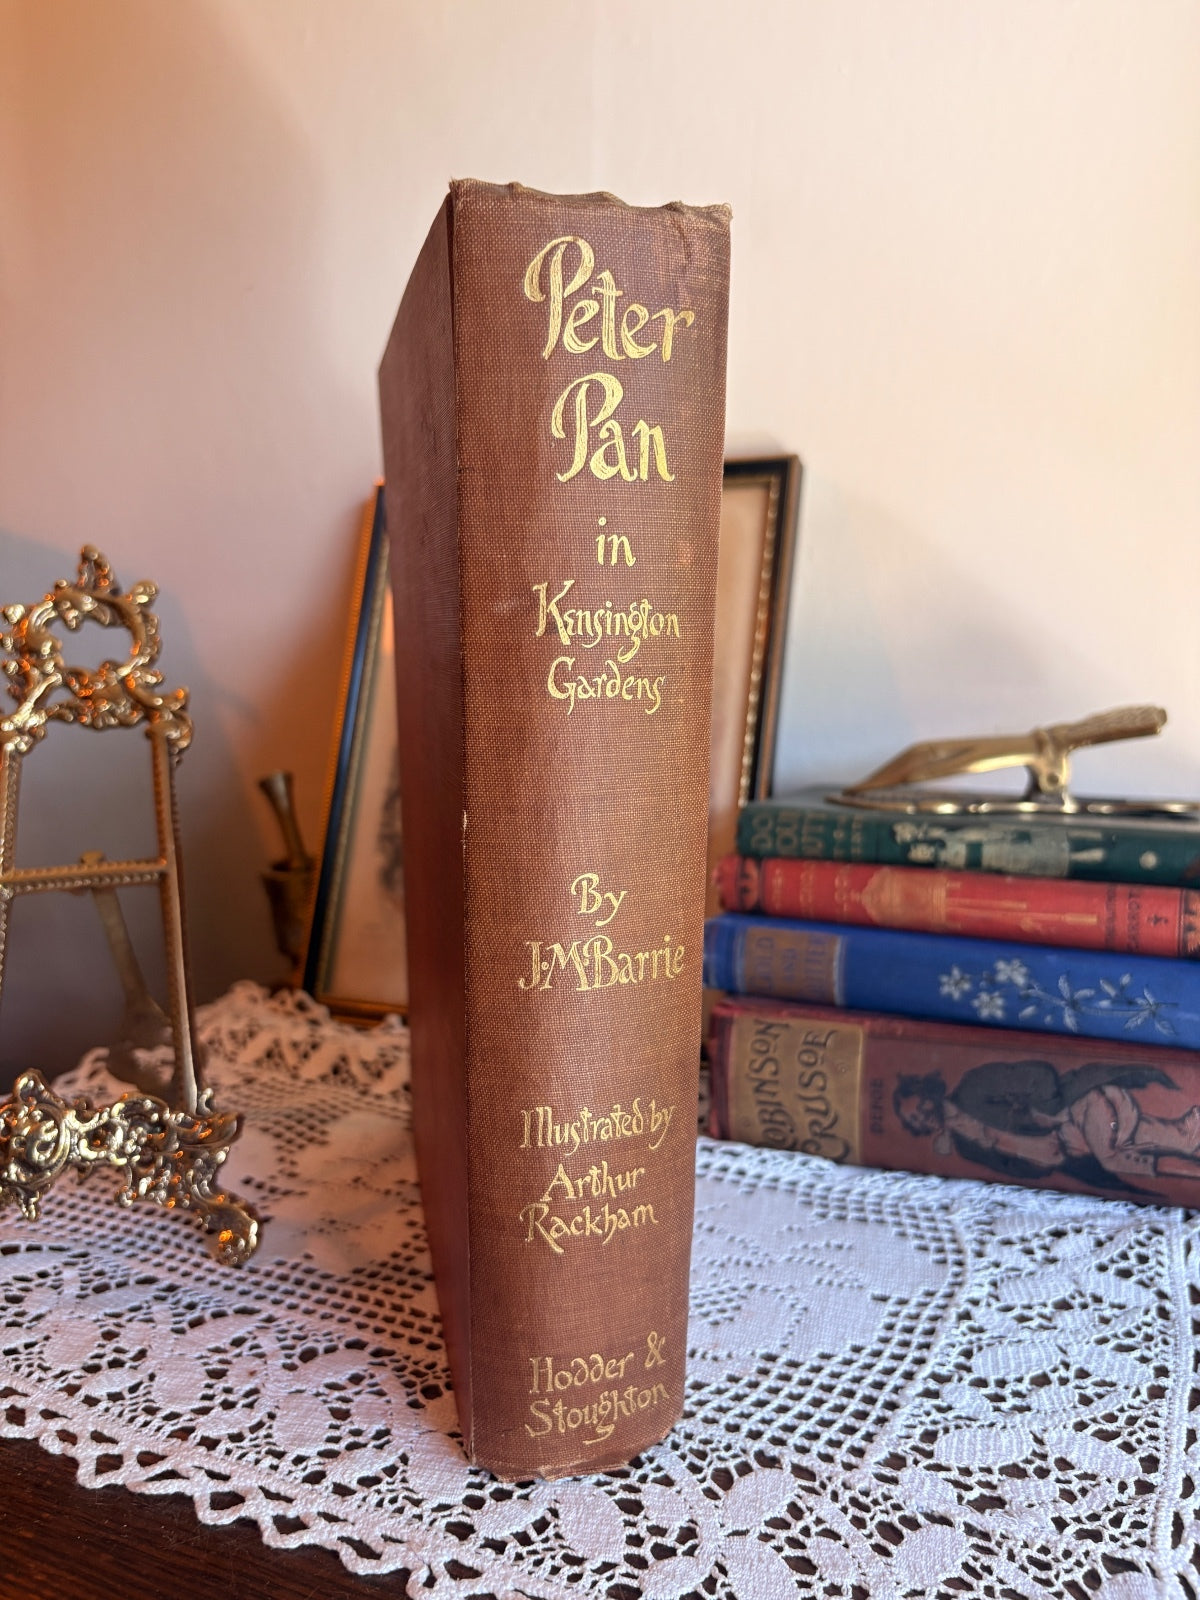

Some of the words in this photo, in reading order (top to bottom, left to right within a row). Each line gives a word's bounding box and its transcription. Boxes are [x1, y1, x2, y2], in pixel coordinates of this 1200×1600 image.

[523, 235, 695, 362] Peter
[551, 372, 675, 483] Pan
[595, 516, 637, 567] in
[532, 579, 681, 664] Kensington
[547, 656, 666, 716] Gardens
[570, 872, 628, 927] By
[797, 1029, 851, 1161] CRUSOE
[519, 1097, 643, 1156] Illustrated
[648, 1099, 677, 1150] by
[539, 1160, 646, 1202] Arthur
[519, 1202, 659, 1254] Rackham
[528, 1352, 635, 1394] Hodder
[644, 1330, 667, 1370] &
[524, 1382, 670, 1446] Stoughton
